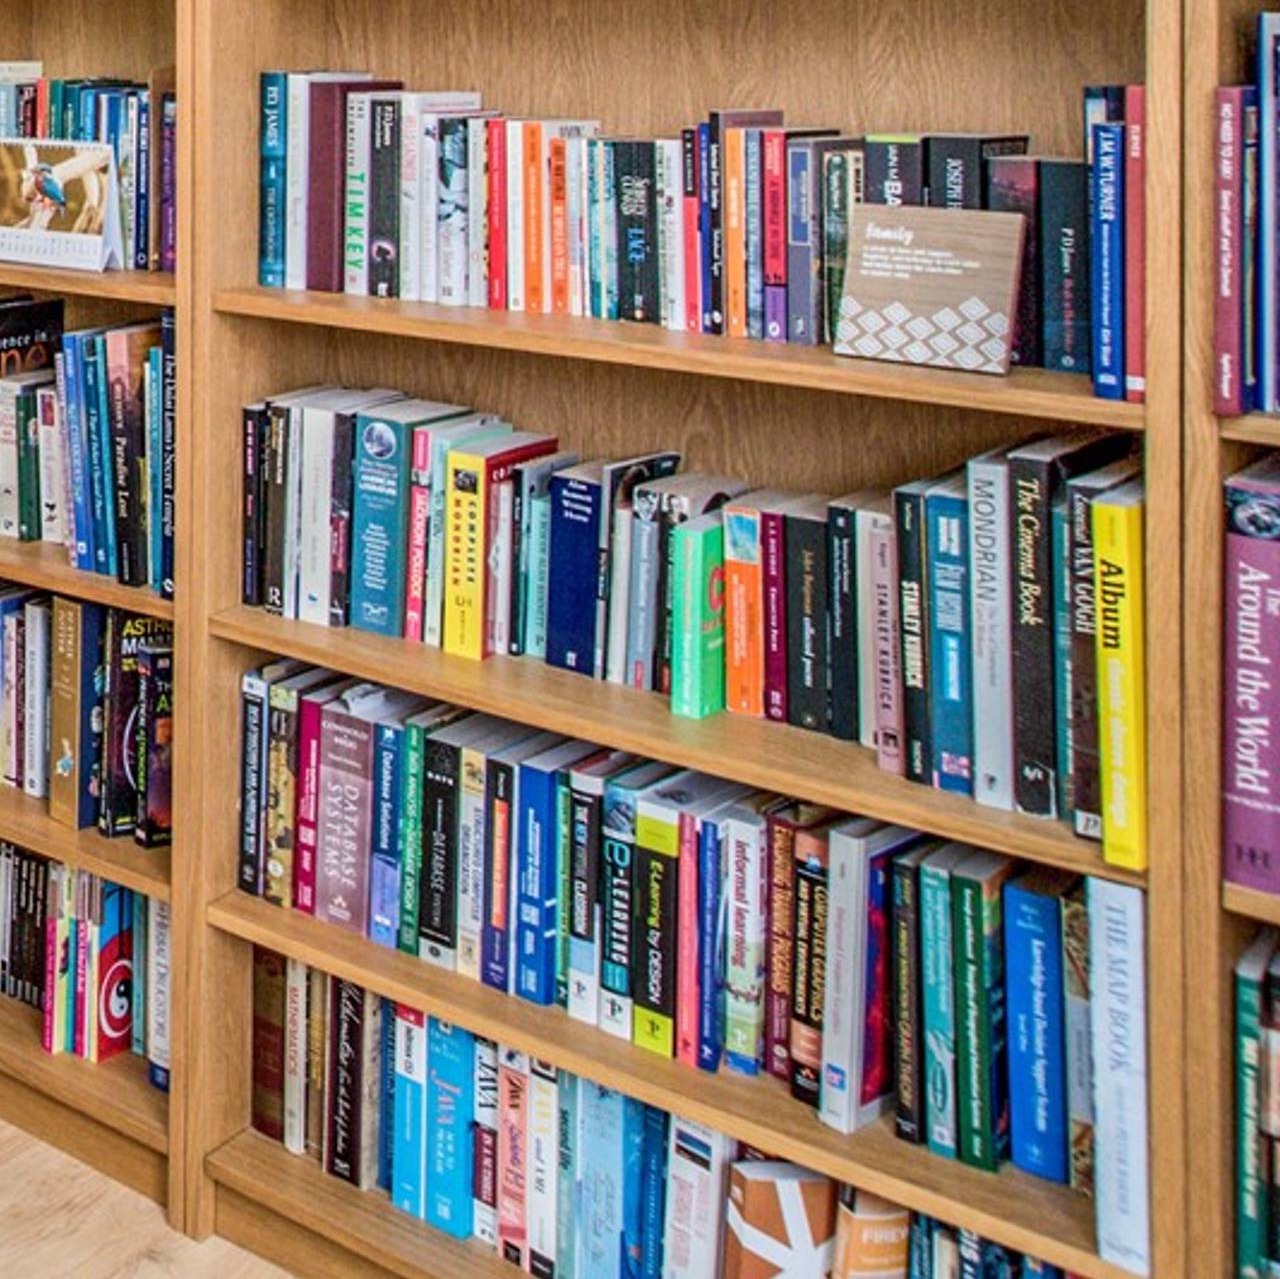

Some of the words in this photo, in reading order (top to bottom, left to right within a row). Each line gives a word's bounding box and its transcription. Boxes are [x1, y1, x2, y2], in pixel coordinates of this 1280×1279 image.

[348, 172, 365, 219] TIM
[946, 158, 963, 199] JOSEPH
[1099, 171, 1115, 221] TURNER
[347, 226, 363, 270] KEY
[627, 228, 646, 263] LACE
[34, 329, 48, 344] in
[413, 492, 429, 547] JACKSON
[1017, 478, 1040, 512] The
[972, 477, 997, 602] MONDRIAN
[1018, 513, 1041, 579] Cinema
[1074, 546, 1096, 580] VAN
[411, 548, 425, 599] POLLOCK
[875, 582, 891, 643] STANLEY
[901, 580, 922, 634] STANLEY
[1019, 581, 1044, 627] Book
[1074, 583, 1097, 636] GOGH
[1099, 559, 1126, 650] Album
[1237, 562, 1269, 661] Around
[878, 648, 892, 712] KUBRICK
[904, 635, 924, 689] KUBRICK
[1237, 667, 1269, 710] the
[1235, 715, 1269, 793] World
[325, 781, 342, 880] SYSTEMS
[342, 784, 360, 887] DATABASE
[431, 830, 445, 891] DATABASE
[735, 839, 750, 904] informal
[604, 839, 630, 964] e-LEARNING
[648, 859, 669, 928] E-Learning
[731, 908, 748, 969] learning
[1106, 904, 1128, 949] THE
[648, 949, 662, 1005] DESIGN
[1107, 953, 1129, 1005] MAP
[1108, 1007, 1131, 1074] BOOK
[430, 1069, 462, 1125] JAVA
[479, 1056, 498, 1111] JAVA
